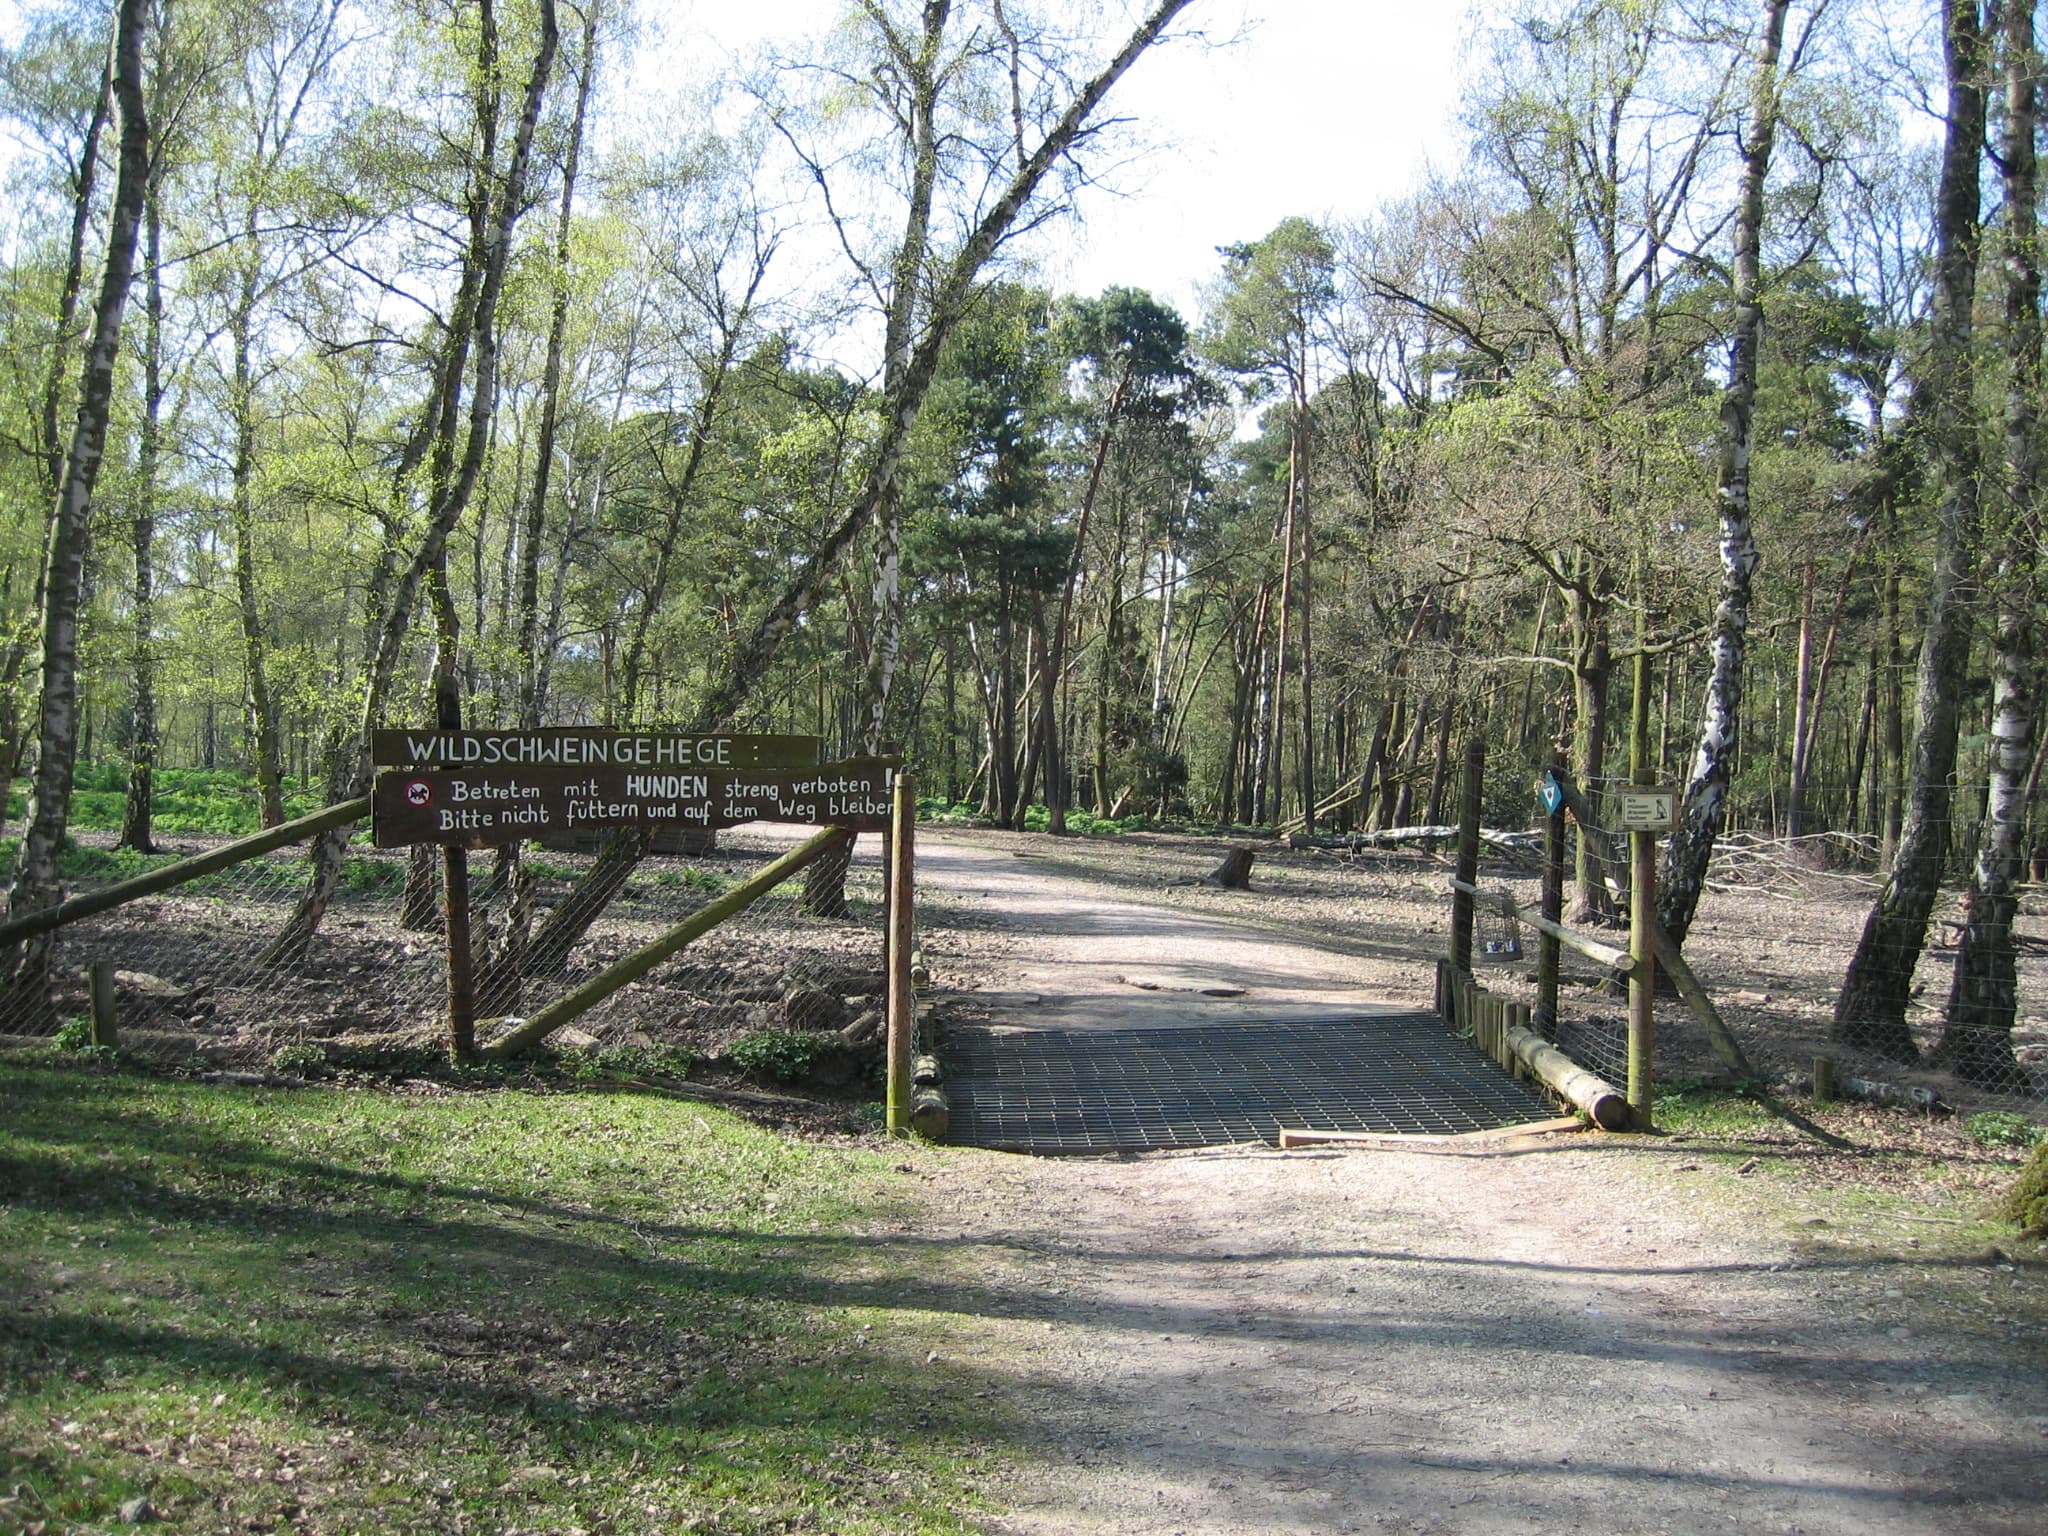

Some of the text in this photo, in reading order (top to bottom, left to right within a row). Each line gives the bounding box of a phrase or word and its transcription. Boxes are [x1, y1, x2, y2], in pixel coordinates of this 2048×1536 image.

[408, 736, 732, 764] WILDSCHWEINGEHEGE
[451, 780, 540, 802] Betreten
[564, 778, 599, 797] mit
[626, 774, 708, 798] HUNDEN
[724, 777, 779, 801] streng
[792, 776, 871, 793] verboten
[439, 809, 494, 831] Bitte
[501, 803, 550, 824] nicht
[566, 800, 639, 827] füttern
[647, 803, 677, 818] und
[684, 800, 713, 826] auf
[723, 800, 758, 818] dem
[778, 799, 816, 824] Weg
